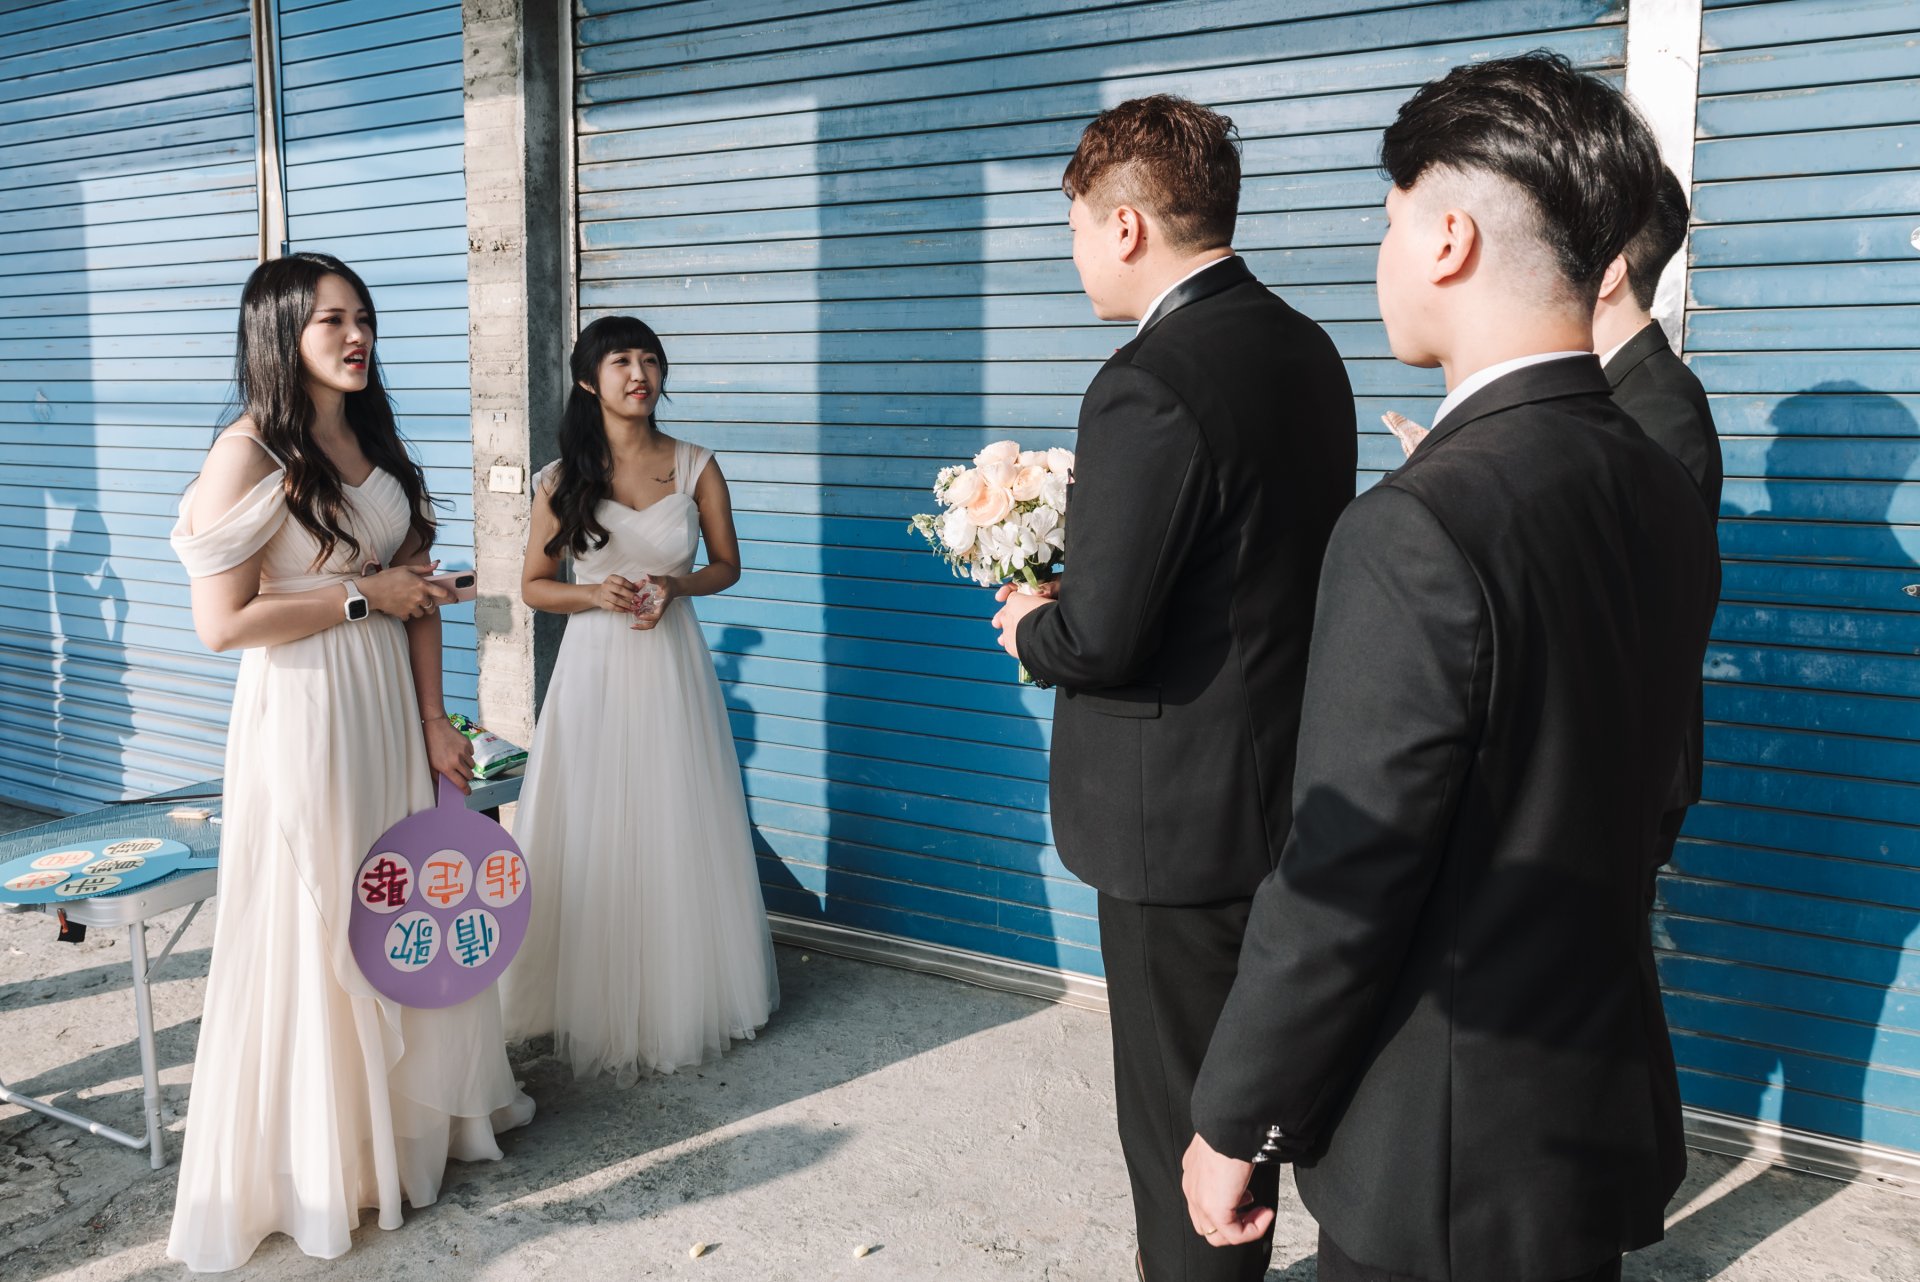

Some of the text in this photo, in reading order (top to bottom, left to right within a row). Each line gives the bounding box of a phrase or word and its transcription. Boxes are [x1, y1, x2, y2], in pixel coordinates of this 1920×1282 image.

[361, 855, 521, 908] 指定娶
[390, 913, 493, 966] 情歌
